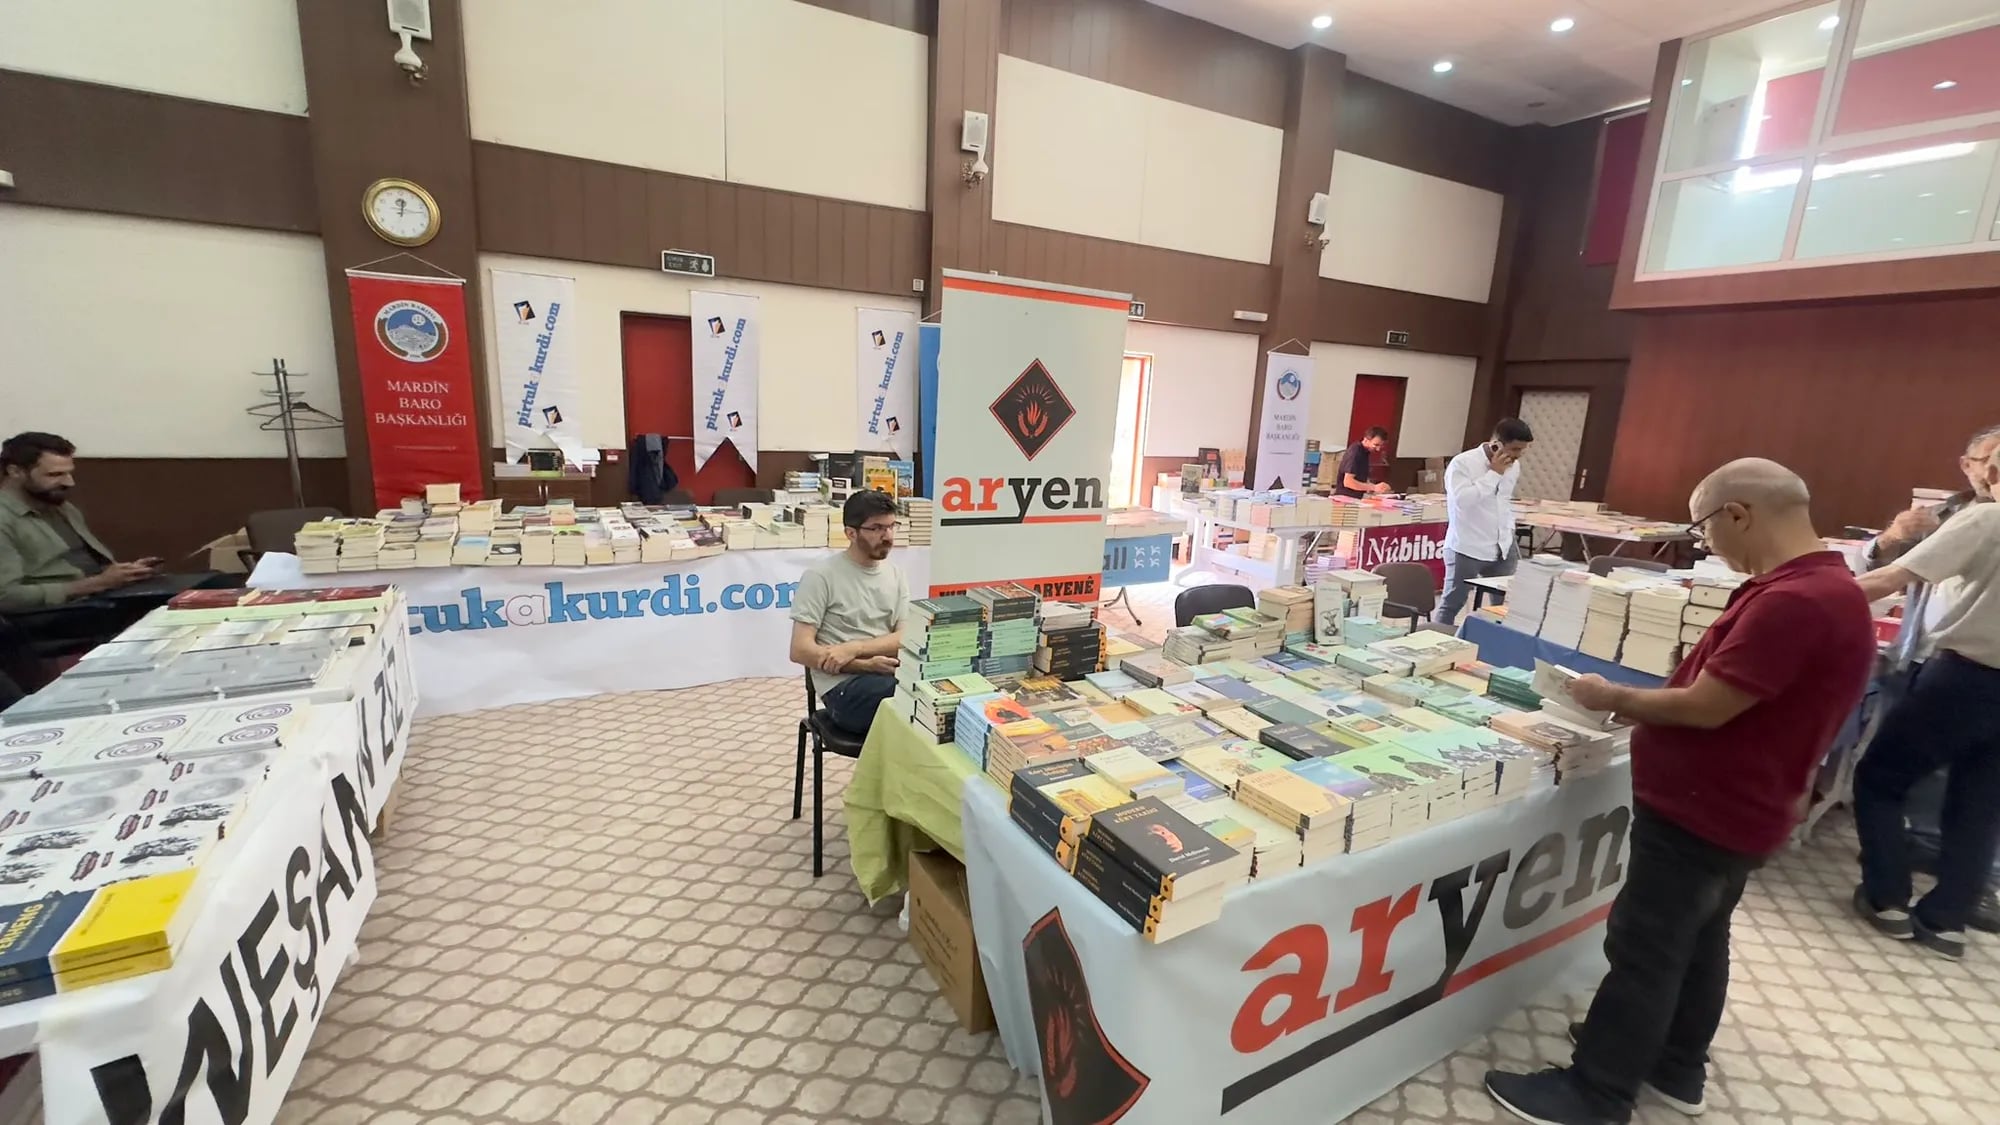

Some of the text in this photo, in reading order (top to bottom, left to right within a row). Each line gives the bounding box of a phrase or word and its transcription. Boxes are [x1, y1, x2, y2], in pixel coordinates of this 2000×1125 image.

[387, 380, 449, 393] MARDİN
[399, 397, 442, 410] BARO
[375, 412, 467, 427] BAŞKANLIĞI
[942, 477, 1103, 523] aryen
[408, 574, 800, 635] ukakurdi.co
[1231, 805, 1632, 1053] aryen
